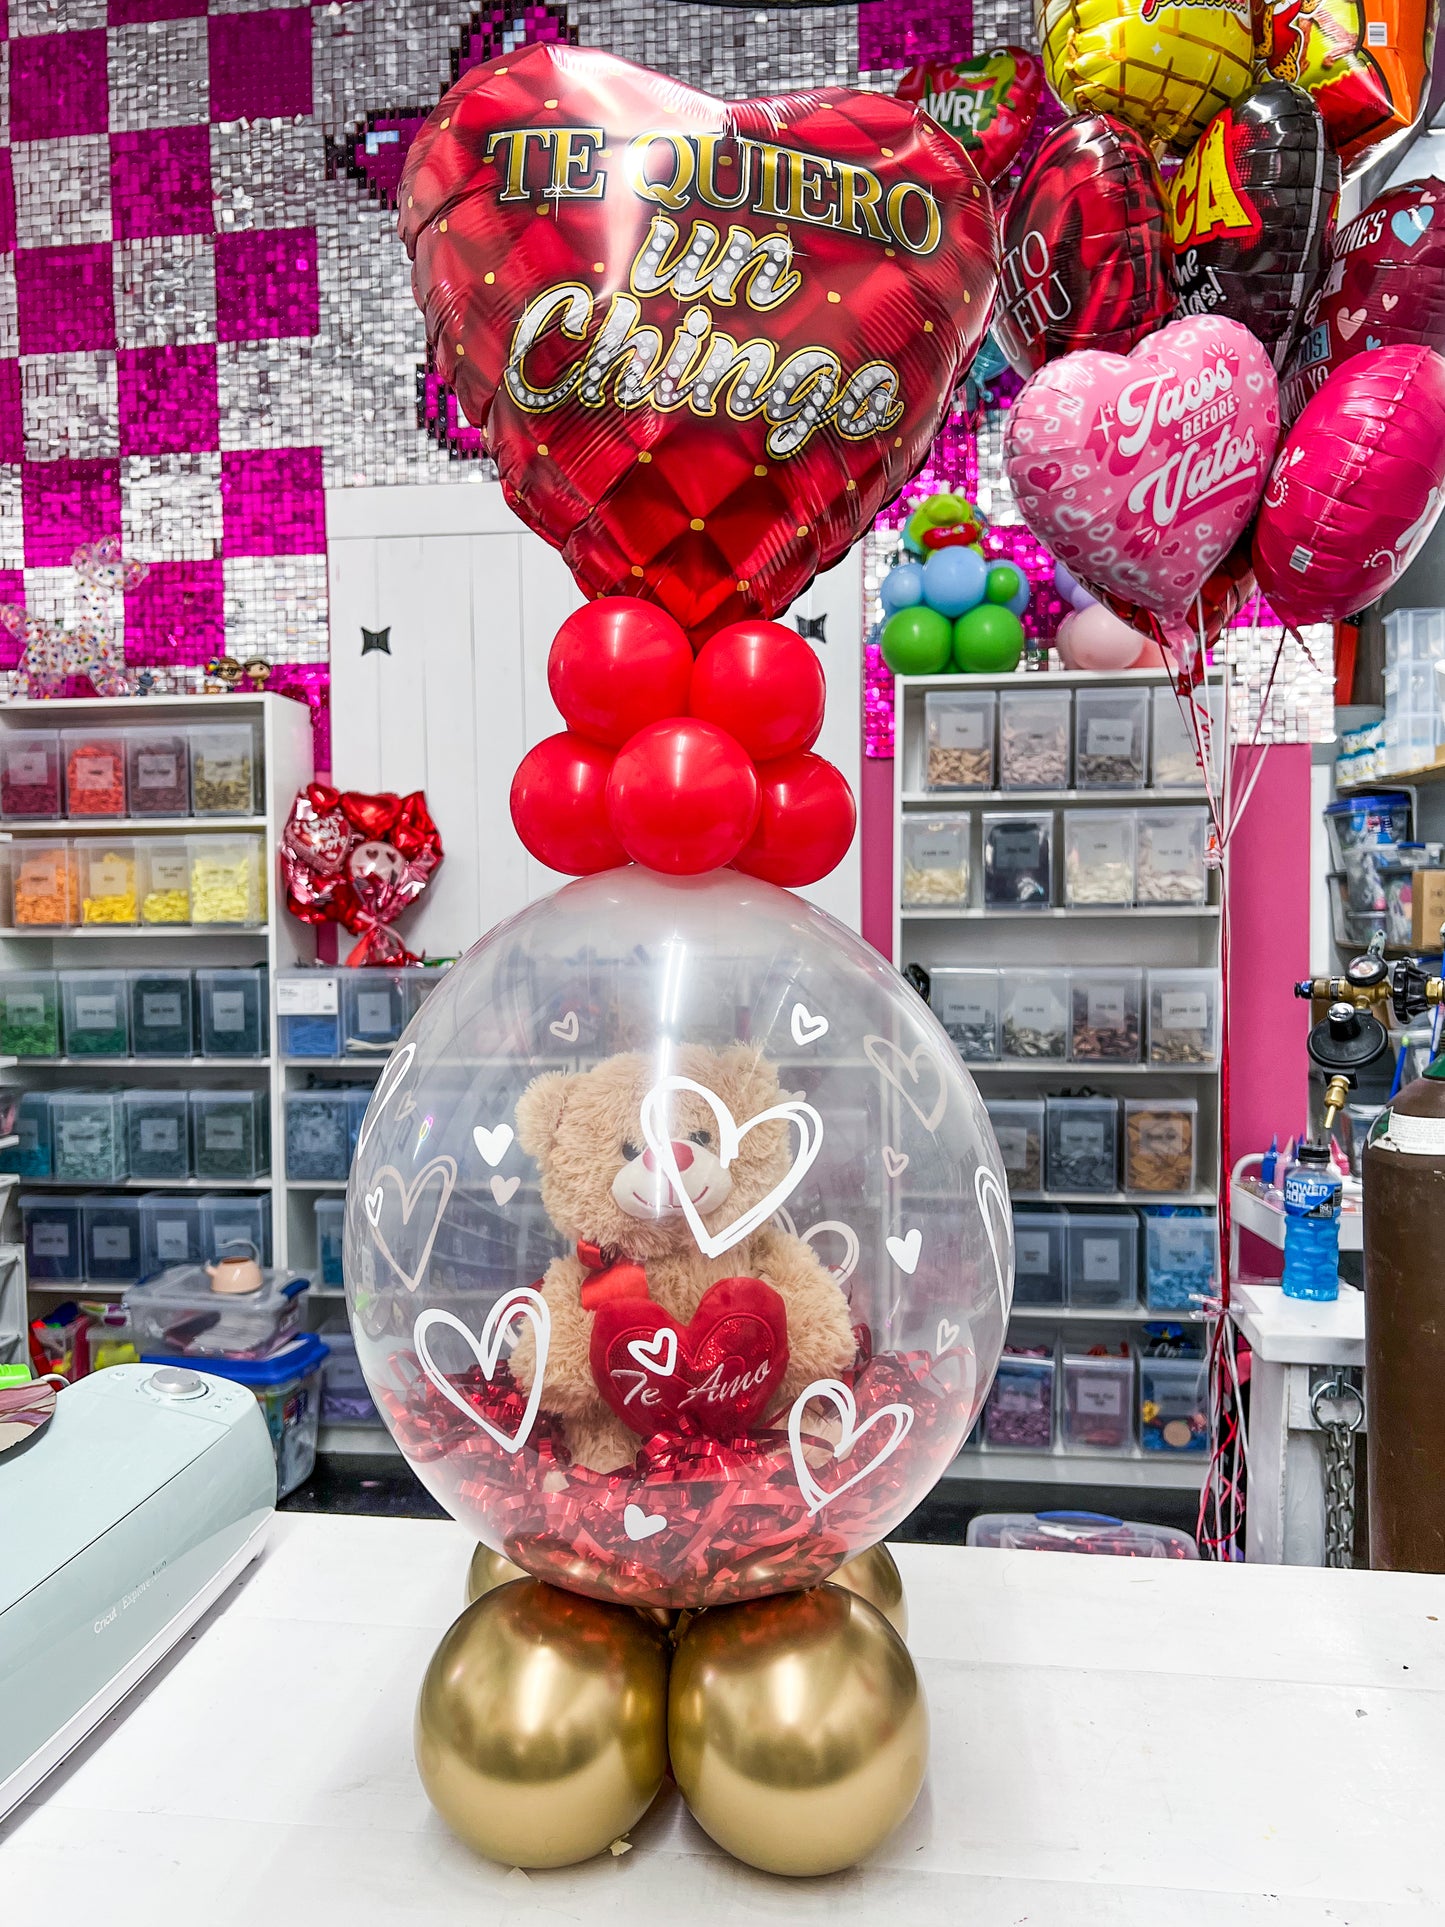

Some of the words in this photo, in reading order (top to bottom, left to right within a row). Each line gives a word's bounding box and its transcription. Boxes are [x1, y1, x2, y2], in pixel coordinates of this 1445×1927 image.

[486, 126, 606, 203] TE
[625, 129, 944, 256] QUIERO
[631, 213, 801, 312] un
[1011, 269, 1073, 347] FIU
[503, 280, 906, 461] Chingo
[1116, 358, 1233, 458] Tacos
[1181, 396, 1236, 442] BEFORE
[1127, 423, 1256, 527] Vatos
[1286, 1179, 1329, 1197] POWER
[609, 1368, 663, 1407] Te
[677, 1358, 772, 1410] Amo
[93, 1606, 119, 1634] Cricut
